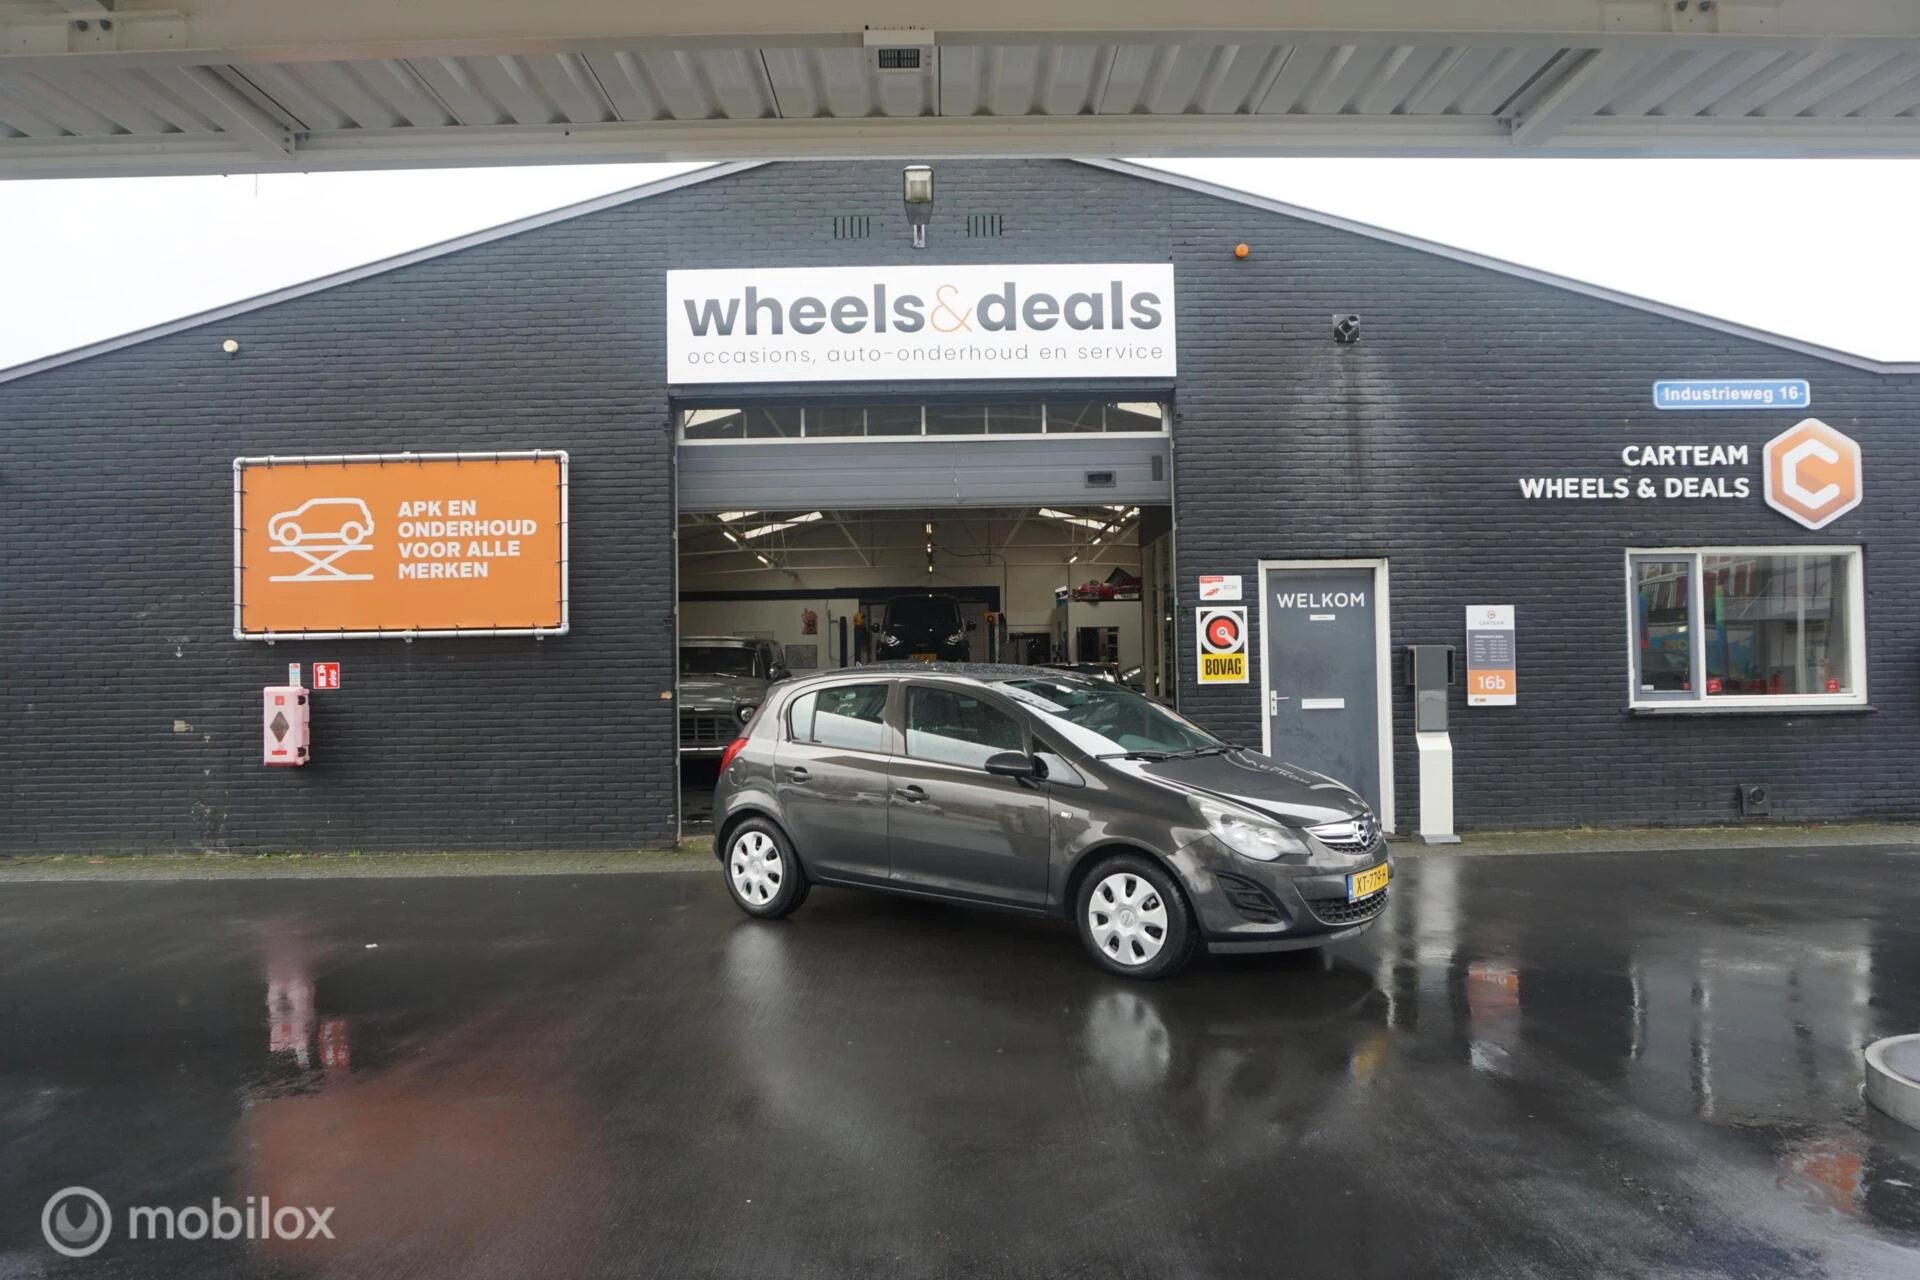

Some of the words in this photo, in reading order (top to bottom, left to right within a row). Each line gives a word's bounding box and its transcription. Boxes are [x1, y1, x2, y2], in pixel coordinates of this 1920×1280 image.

[684, 281, 1162, 336] wheels&deals
[687, 347, 816, 365] occasions,
[827, 344, 1028, 362] auto-onderhoud
[1039, 348, 1067, 360] en
[1077, 344, 1163, 360] service
[1664, 386, 1773, 403] Industrieweg
[1779, 385, 1798, 400] 16
[1621, 444, 1749, 467] CARTEAM
[1518, 477, 1630, 499] WHEELS
[1636, 477, 1657, 499] &
[1664, 477, 1750, 498] DEALS
[398, 501, 443, 517] APK
[448, 500, 477, 517] EN
[398, 519, 537, 537] ONDERHOUD
[398, 541, 461, 558] VOOR
[467, 540, 521, 557] ALLE
[398, 561, 489, 579] MERKEN
[1276, 592, 1365, 609] WELKOM
[1205, 658, 1242, 676] BOVAG
[1478, 675, 1506, 690] 16b
